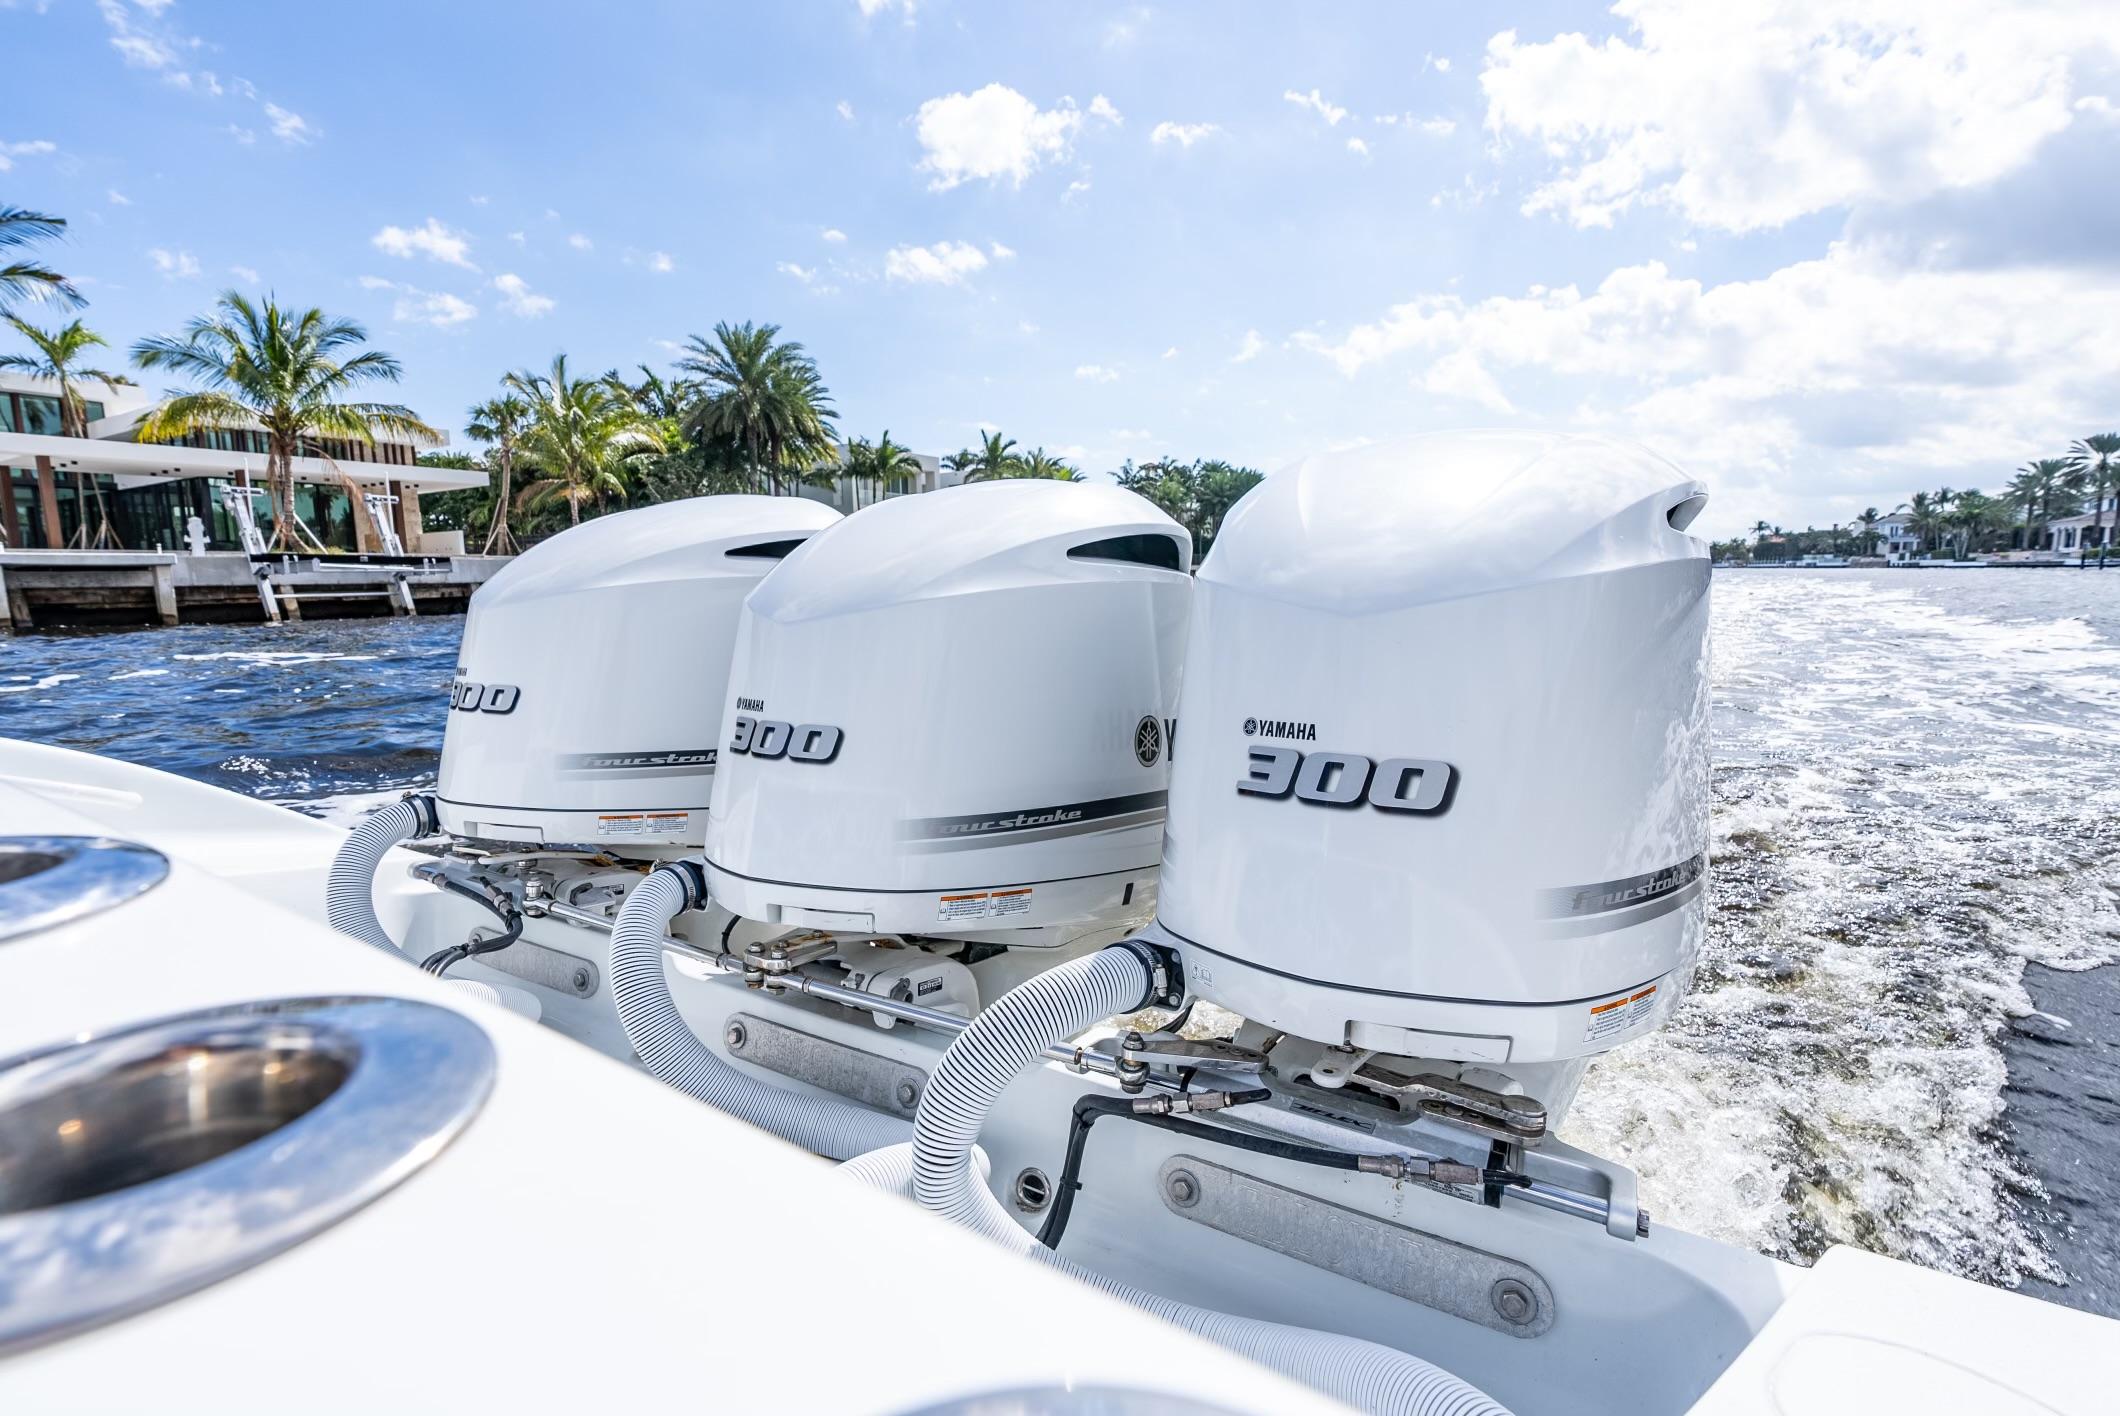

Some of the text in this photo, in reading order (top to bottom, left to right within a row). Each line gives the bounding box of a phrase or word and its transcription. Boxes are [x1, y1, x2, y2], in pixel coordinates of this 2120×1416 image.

[741, 697, 764, 712] YAMAHA
[730, 716, 844, 764] 300
[1259, 719, 1317, 741] YAMAHA
[649, 751, 717, 764] strok
[1236, 745, 1459, 817] 300
[936, 809, 1082, 834] our stroke
